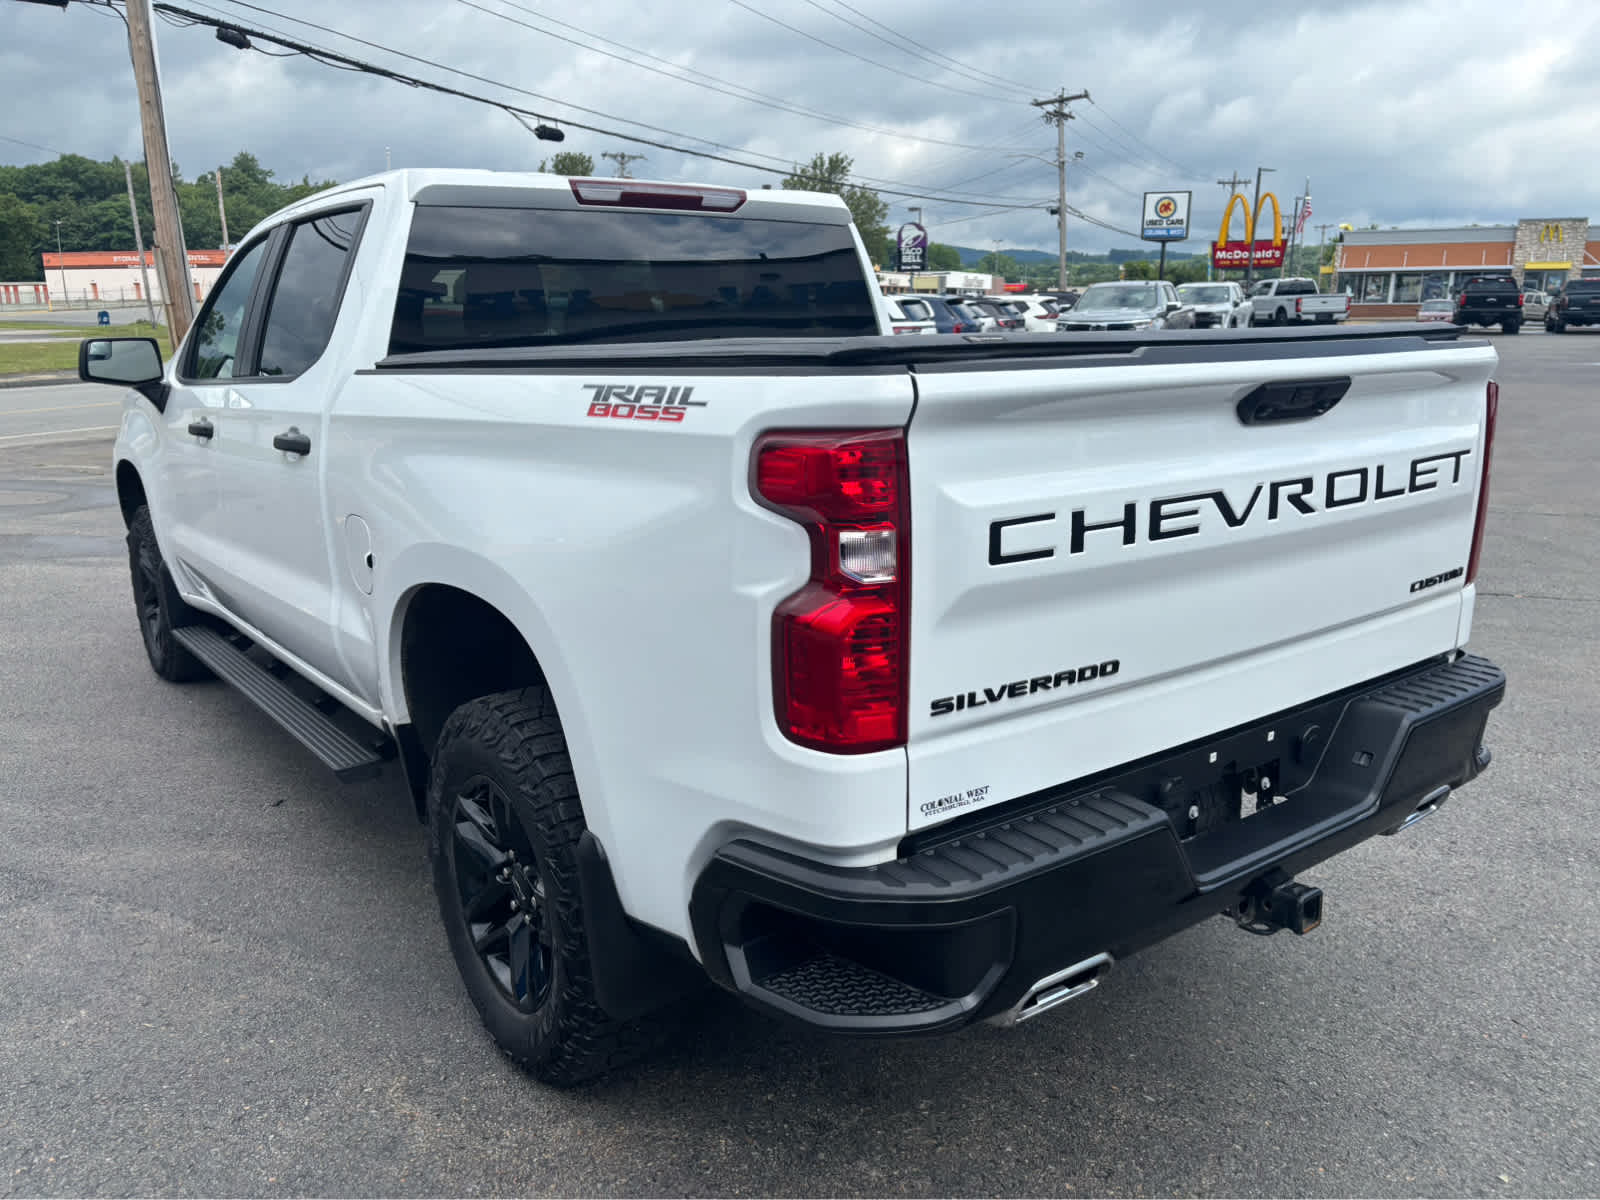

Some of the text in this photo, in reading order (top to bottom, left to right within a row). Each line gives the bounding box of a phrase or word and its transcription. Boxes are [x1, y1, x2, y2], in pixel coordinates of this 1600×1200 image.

[1159, 201, 1173, 214] OK
[901, 247, 922, 255] TACO
[902, 255, 923, 263] BELL
[583, 384, 708, 406] TRAIL
[587, 403, 687, 422] BOSS
[988, 448, 1472, 566] CHEVROLET
[1409, 566, 1464, 593] CUSTOM
[930, 659, 1121, 717] SILVERADO
[920, 785, 989, 812] COLONIAL WEST
